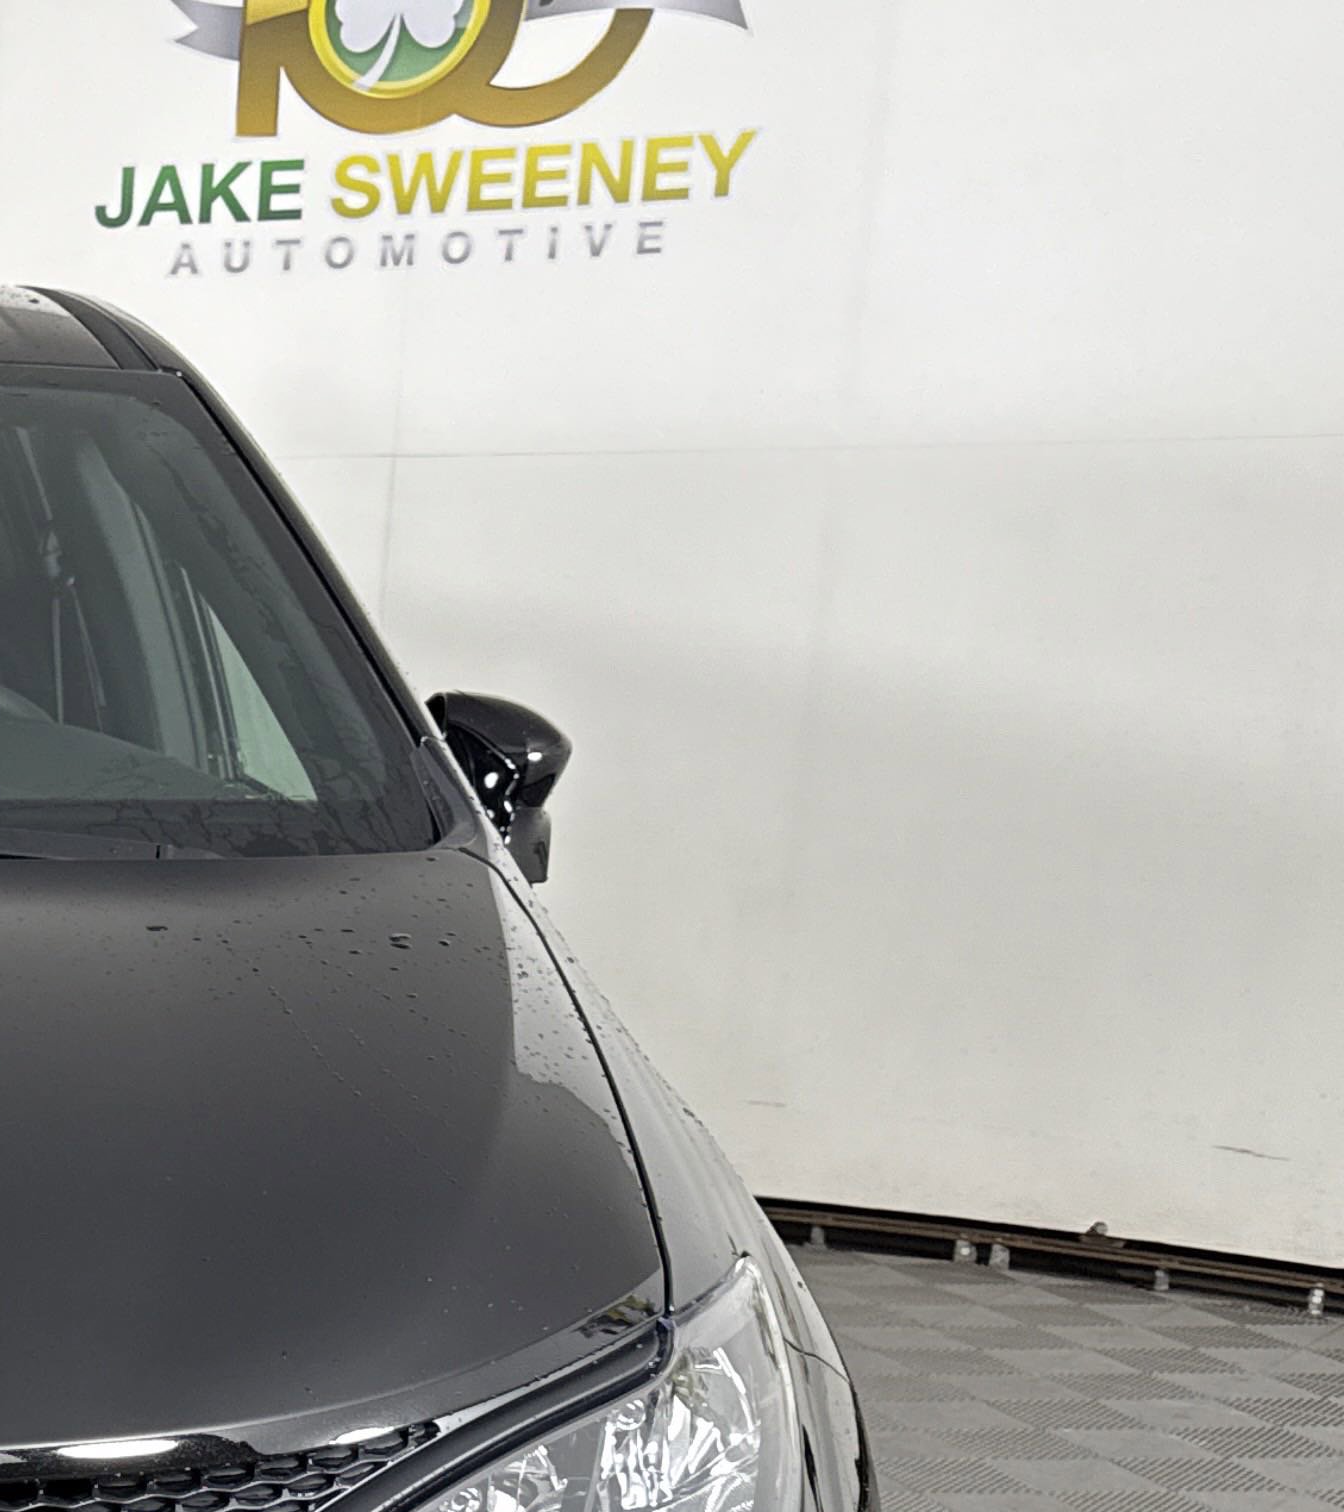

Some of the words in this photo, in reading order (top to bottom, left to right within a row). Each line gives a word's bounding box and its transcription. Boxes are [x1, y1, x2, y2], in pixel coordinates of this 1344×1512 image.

[95, 159, 305, 229] JAKE
[330, 130, 756, 219] SWEENEY
[169, 221, 666, 276] AUTOMOTIVE
